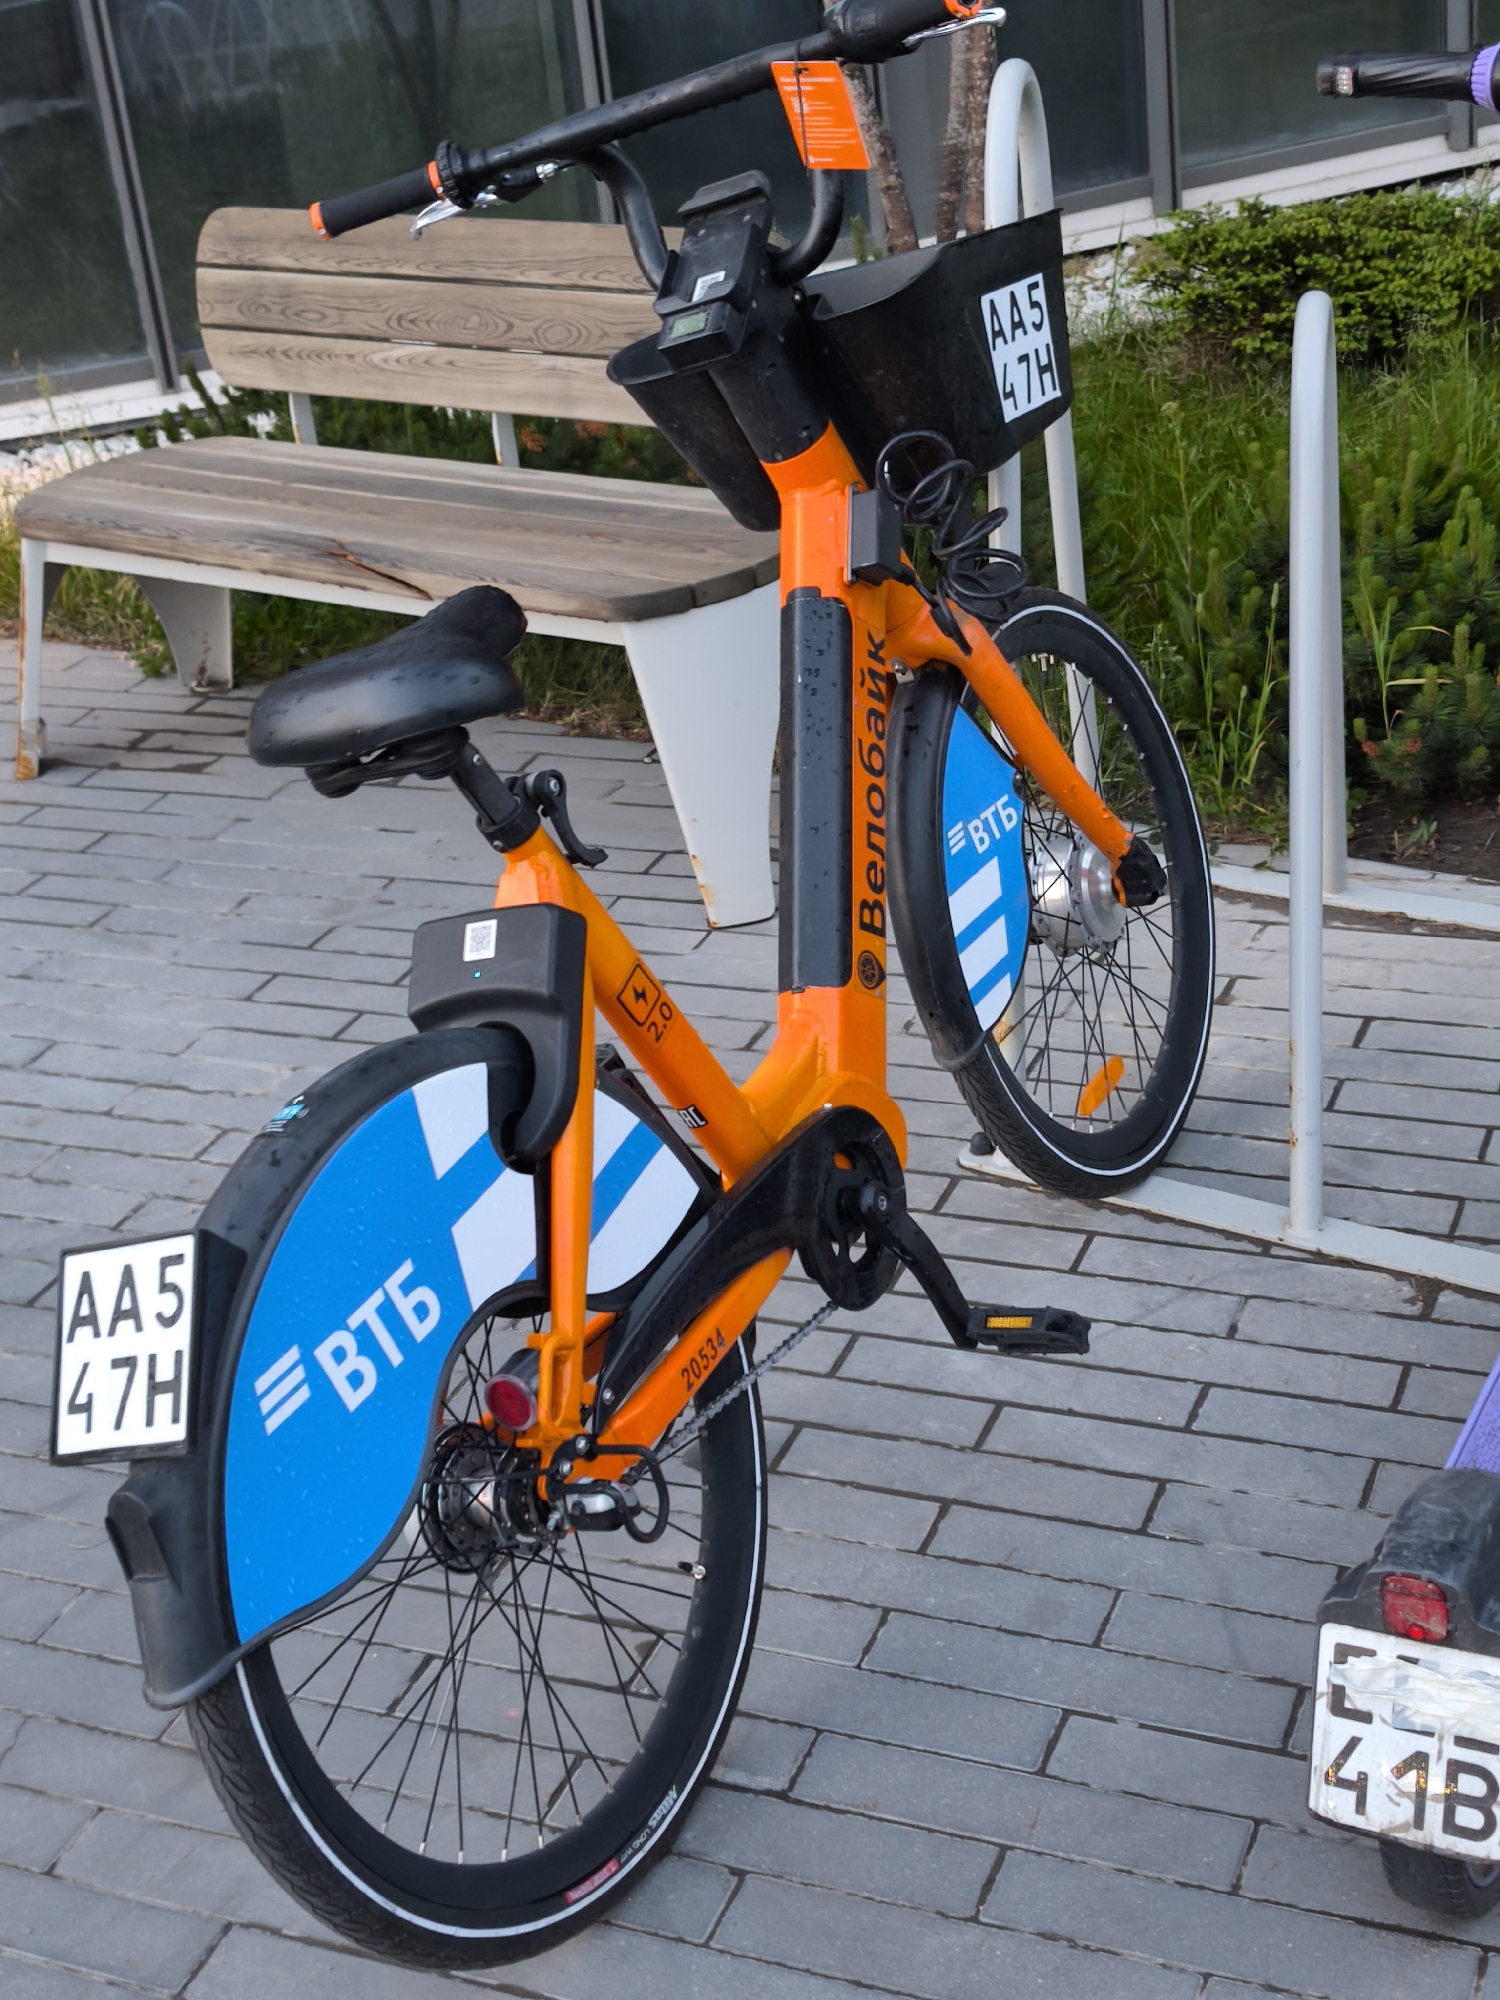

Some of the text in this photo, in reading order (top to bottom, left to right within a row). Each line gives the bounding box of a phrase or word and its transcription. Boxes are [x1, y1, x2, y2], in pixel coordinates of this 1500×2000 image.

[857, 630, 886, 940] Велобайк
[967, 793, 1018, 855] ВТБ
[646, 1001, 673, 1043] 2.0
[313, 1257, 441, 1413] ВТБ
[681, 1326, 726, 1392] 20534
[647, 1785, 677, 1830] Mitas
